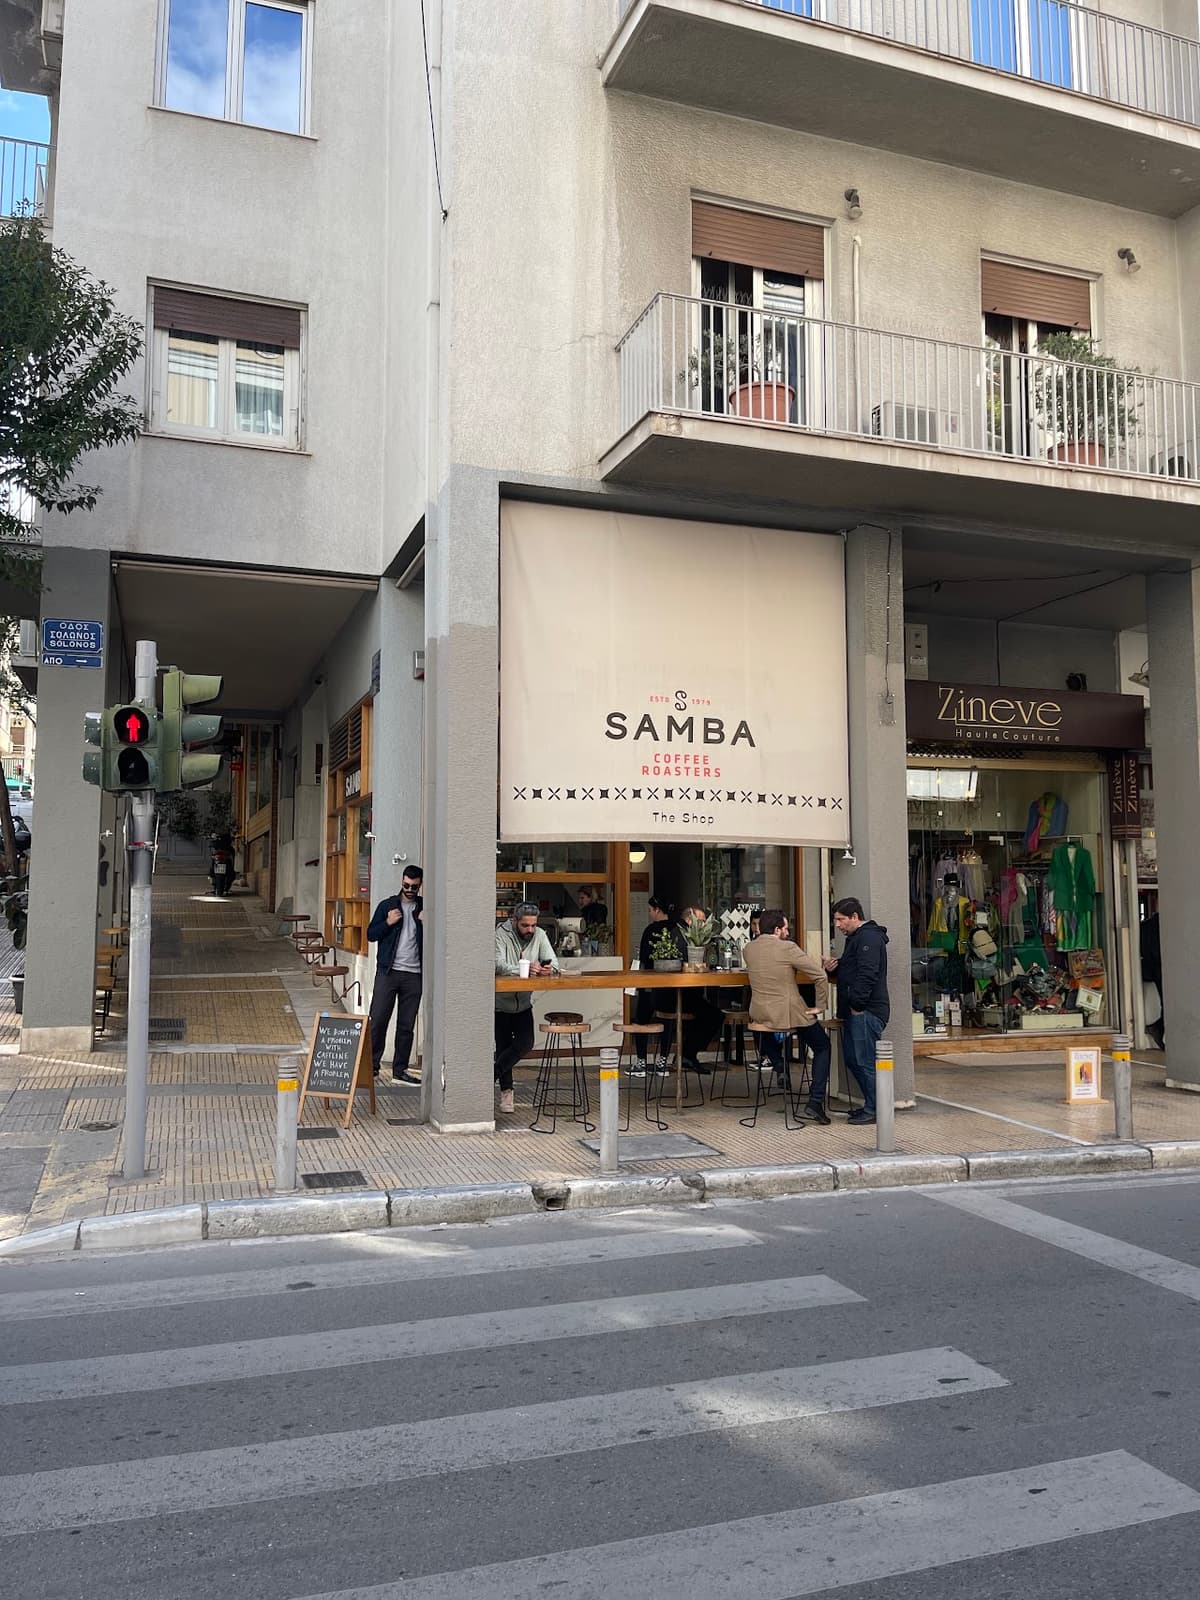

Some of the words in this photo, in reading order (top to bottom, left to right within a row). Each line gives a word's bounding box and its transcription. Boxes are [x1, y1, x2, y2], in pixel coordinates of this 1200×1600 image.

[60, 622, 89, 631] ΟΔΟΣ
[50, 631, 96, 641] ΣΟΛΩΝΟΣ
[50, 640, 96, 649] SOLONOS
[44, 657, 63, 665] ΑΠΟ
[937, 685, 1063, 727] Zineve
[604, 712, 756, 748] SAMBA
[955, 729, 998, 741] Haute
[1002, 730, 1061, 743] Couture
[654, 753, 710, 765] COFFEE
[641, 765, 722, 778] ROASTERS
[652, 812, 676, 824] The
[682, 812, 715, 826] Shop
[319, 1026, 331, 1035] WE
[313, 1059, 326, 1067] WE
[329, 1060, 348, 1069] HAVE
[314, 1070, 319, 1078] A
